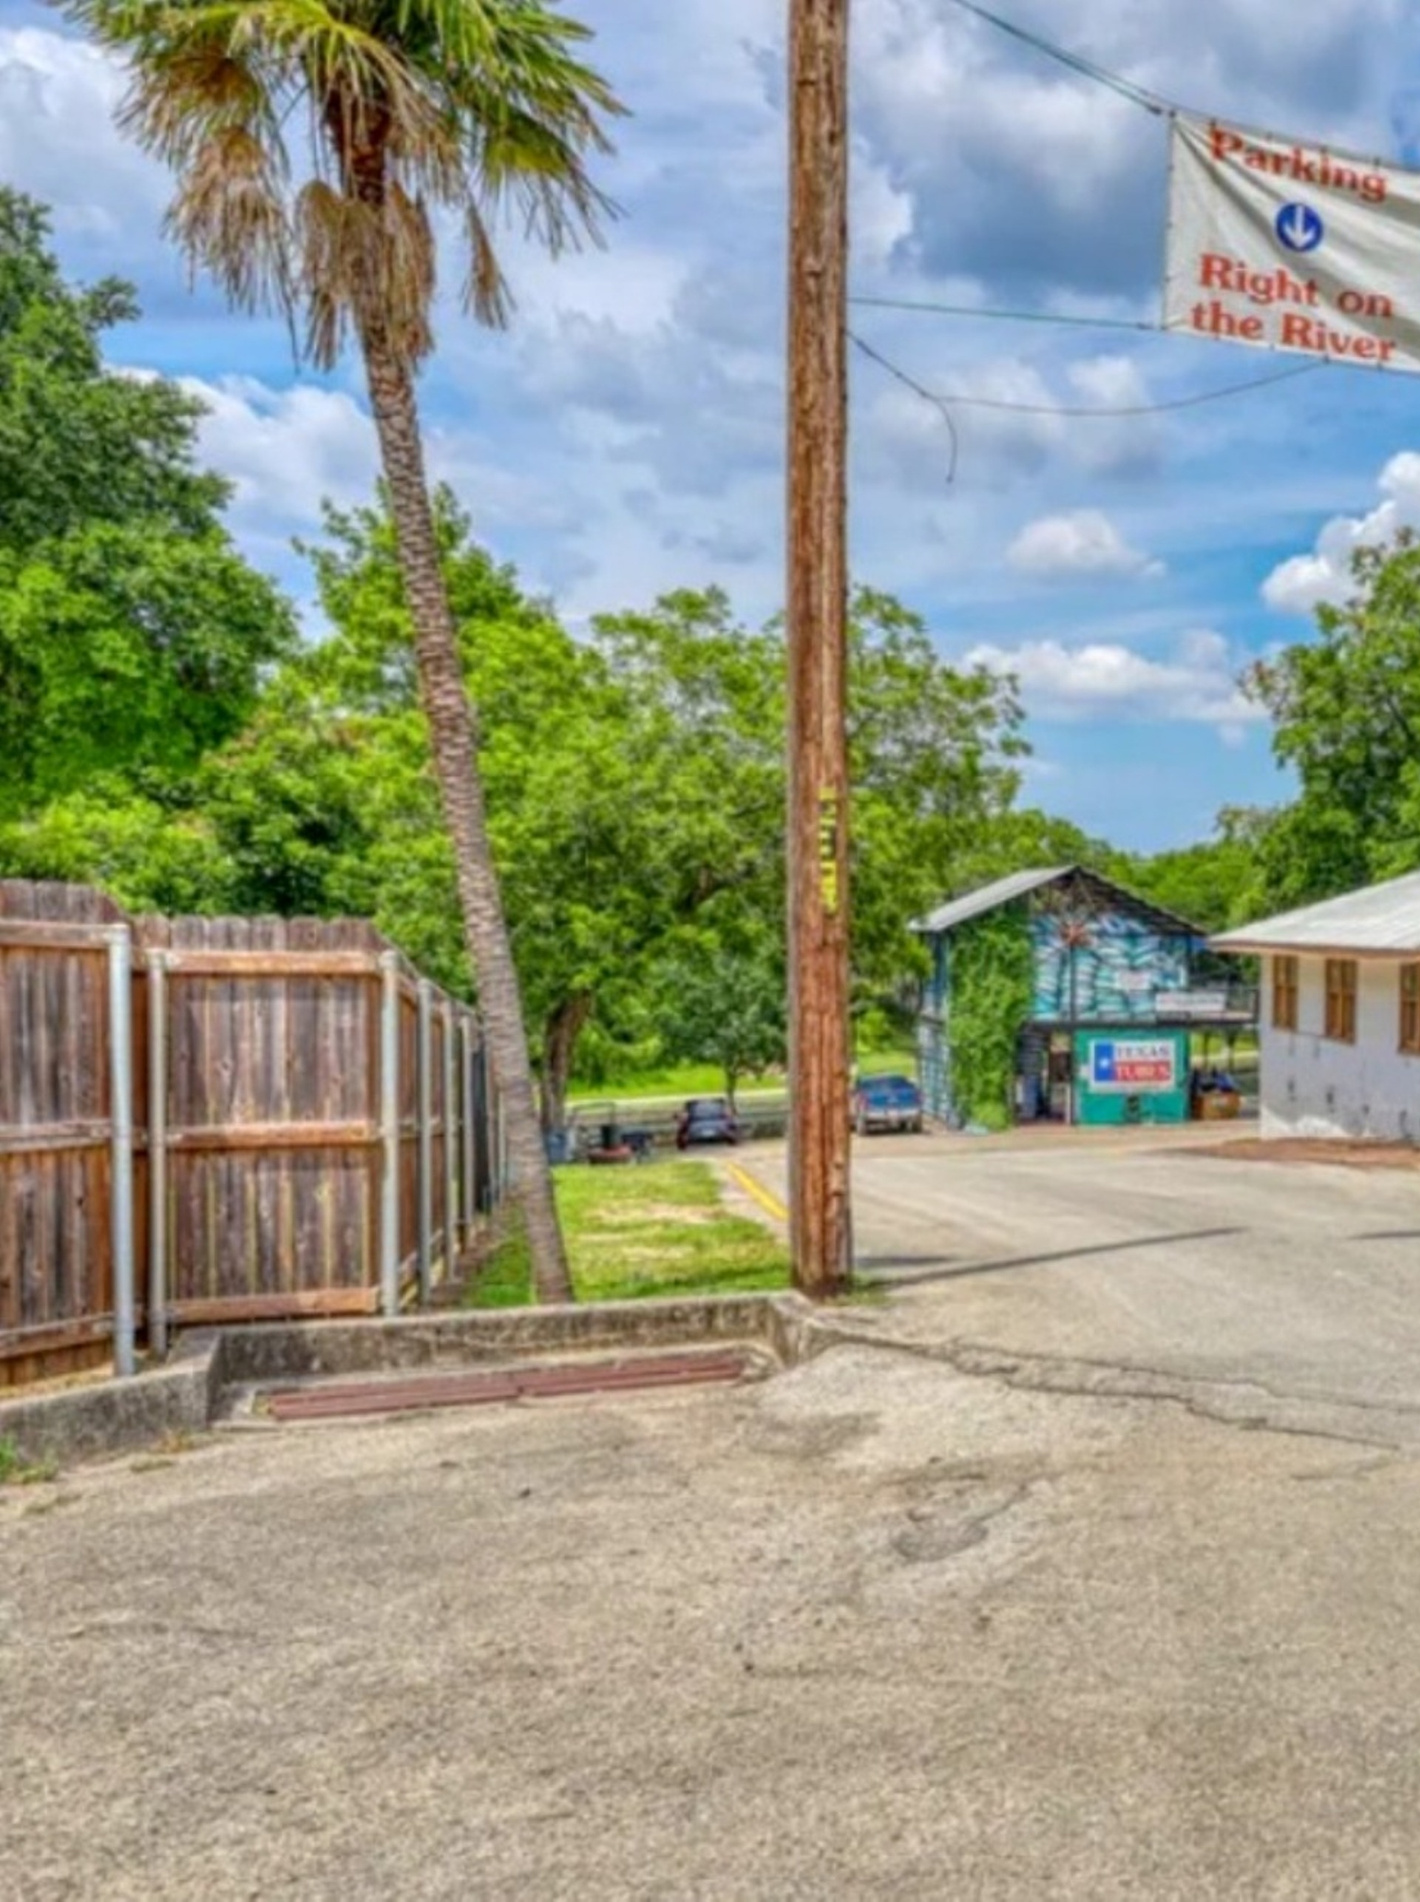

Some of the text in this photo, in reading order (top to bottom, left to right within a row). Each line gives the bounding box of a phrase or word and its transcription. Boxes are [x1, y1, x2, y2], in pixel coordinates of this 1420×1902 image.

[1210, 128, 1386, 203] Parking
[1199, 253, 1393, 318] Right on
[1191, 300, 1397, 361] the River
